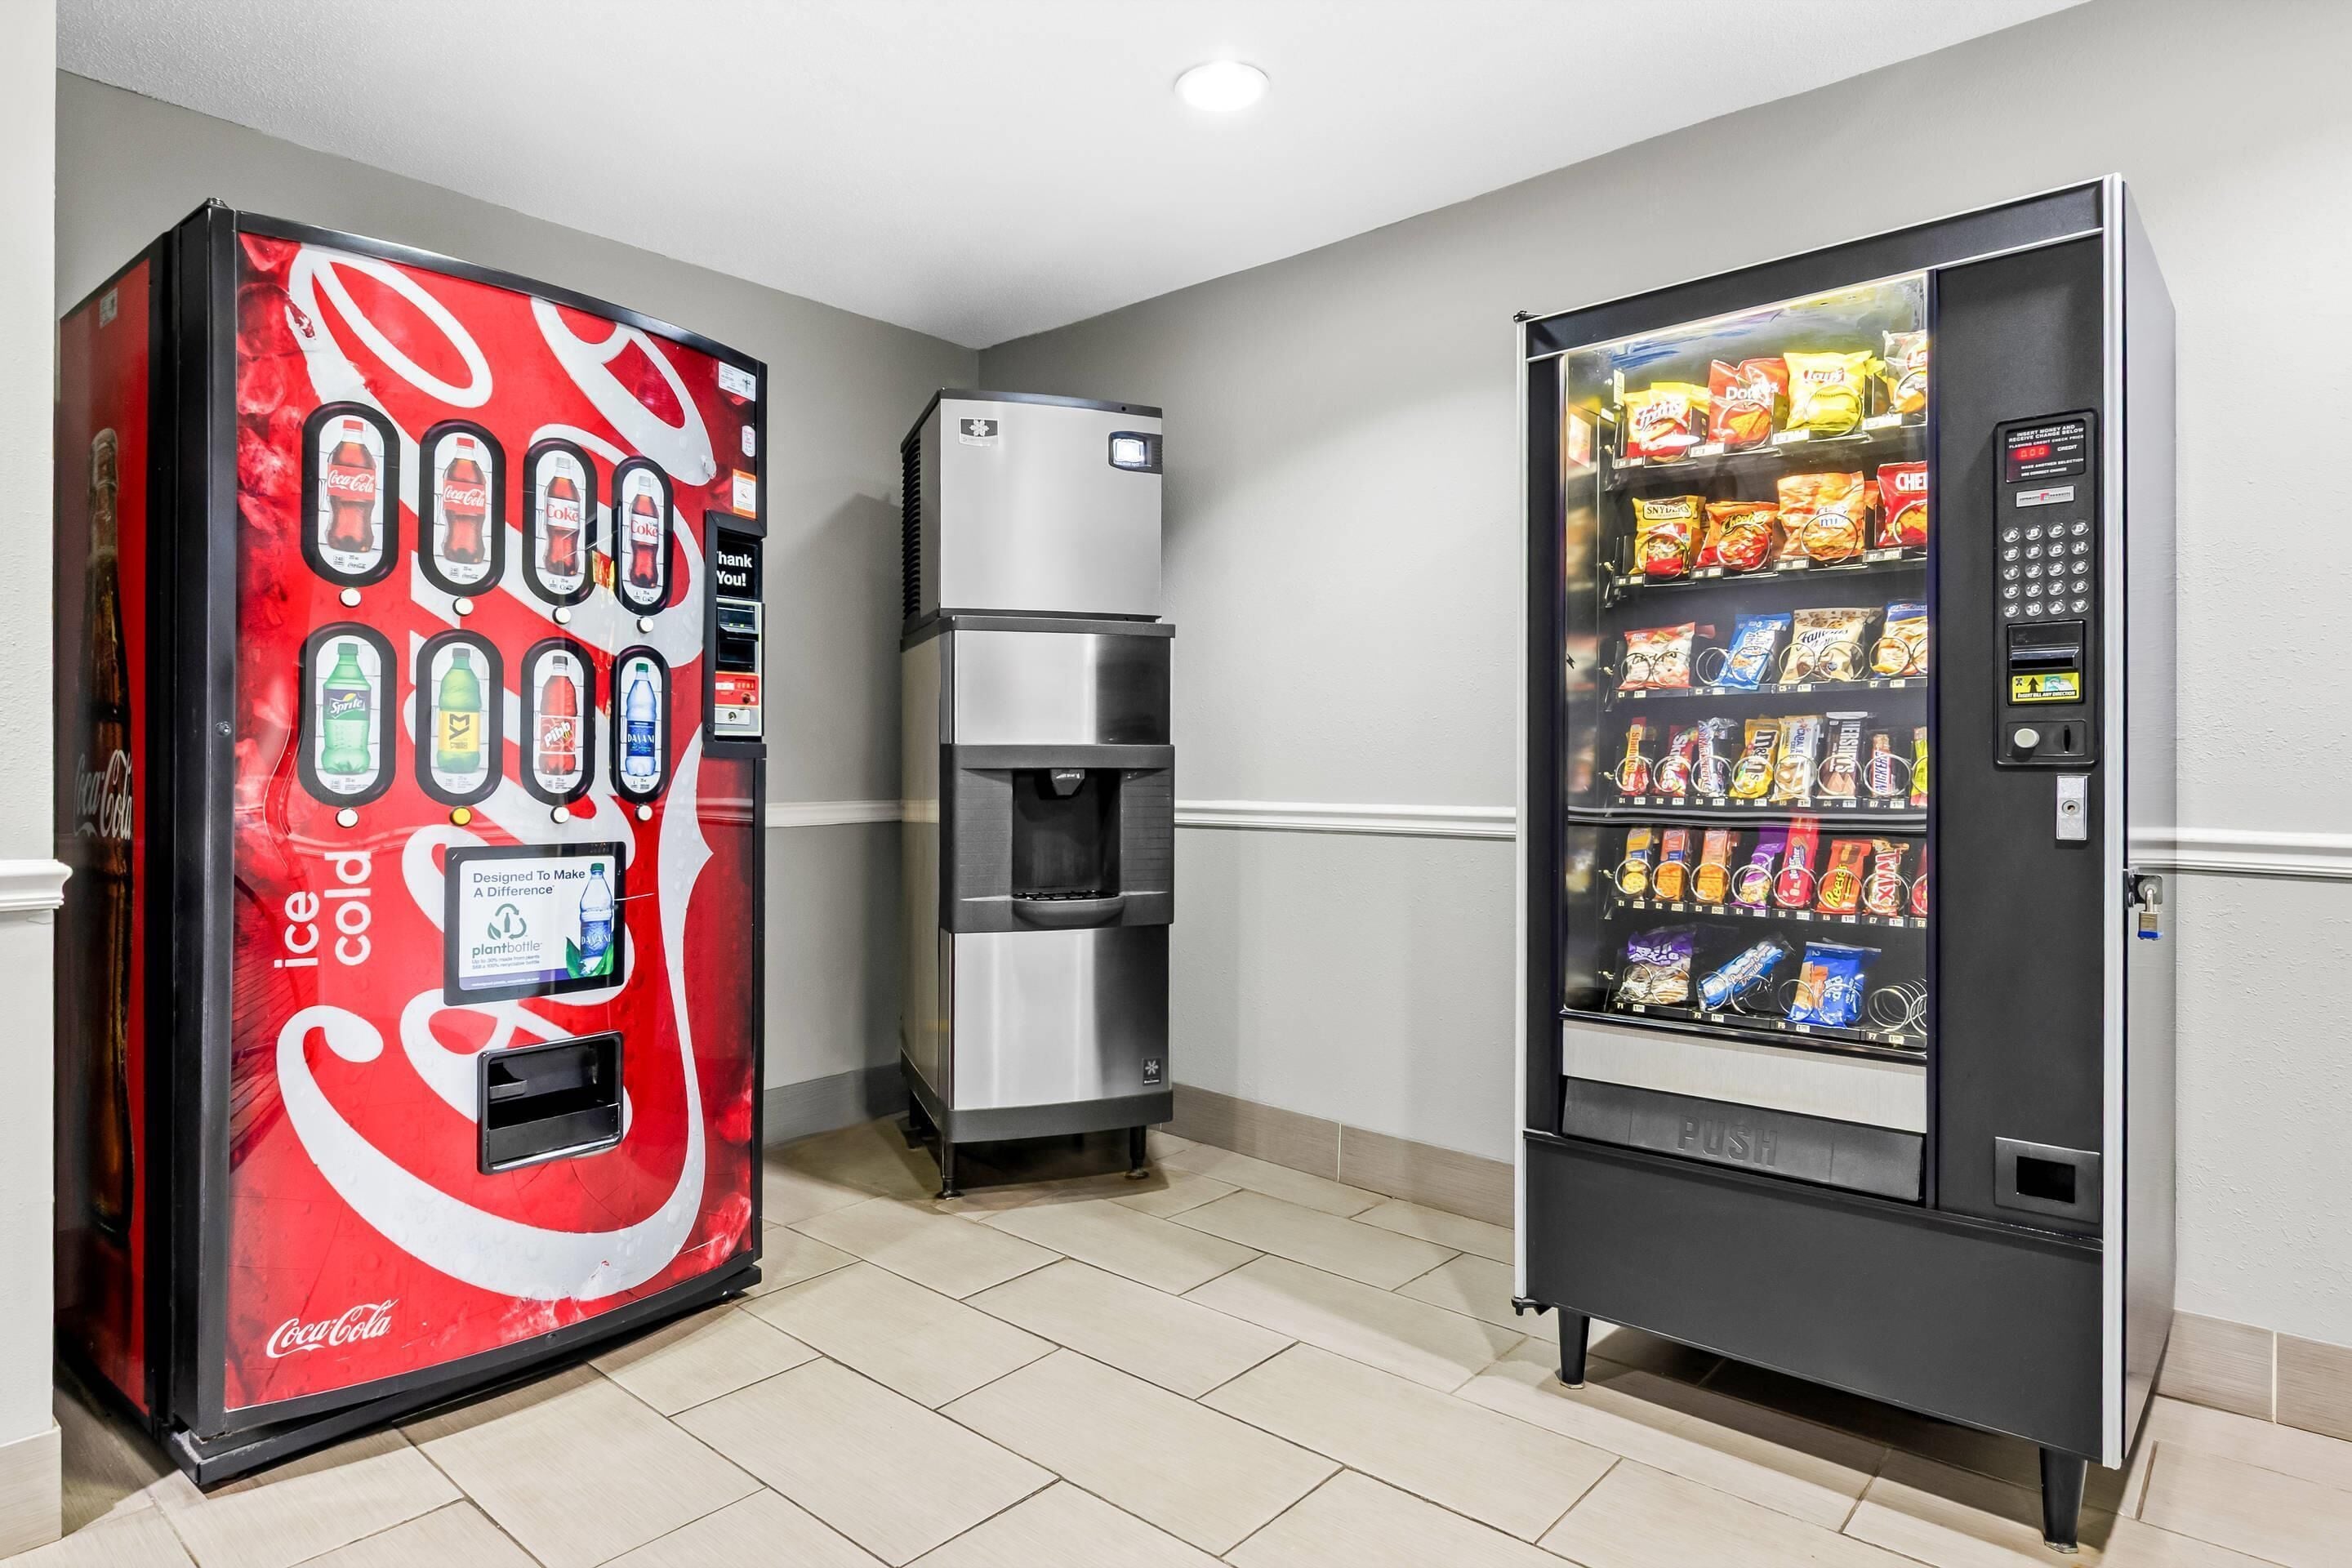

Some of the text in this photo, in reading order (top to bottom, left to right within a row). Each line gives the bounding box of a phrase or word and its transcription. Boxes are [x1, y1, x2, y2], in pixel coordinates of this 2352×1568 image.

[327, 470, 375, 493] Coca-Cola
[443, 485, 484, 507] Coca-Cola
[546, 503, 579, 523] Coke
[631, 519, 658, 537] Coke
[715, 570, 746, 586] You!
[330, 698, 363, 715] Sprite
[72, 749, 132, 840] Coca-Cola
[473, 870, 586, 884] Designed To Make
[1824, 863, 1847, 907] Reese's
[474, 888, 483, 898] A
[323, 851, 372, 965] cold
[274, 891, 319, 969] ice
[1677, 1114, 1777, 1168] PUSH
[266, 1298, 399, 1359] Coca-Cola
